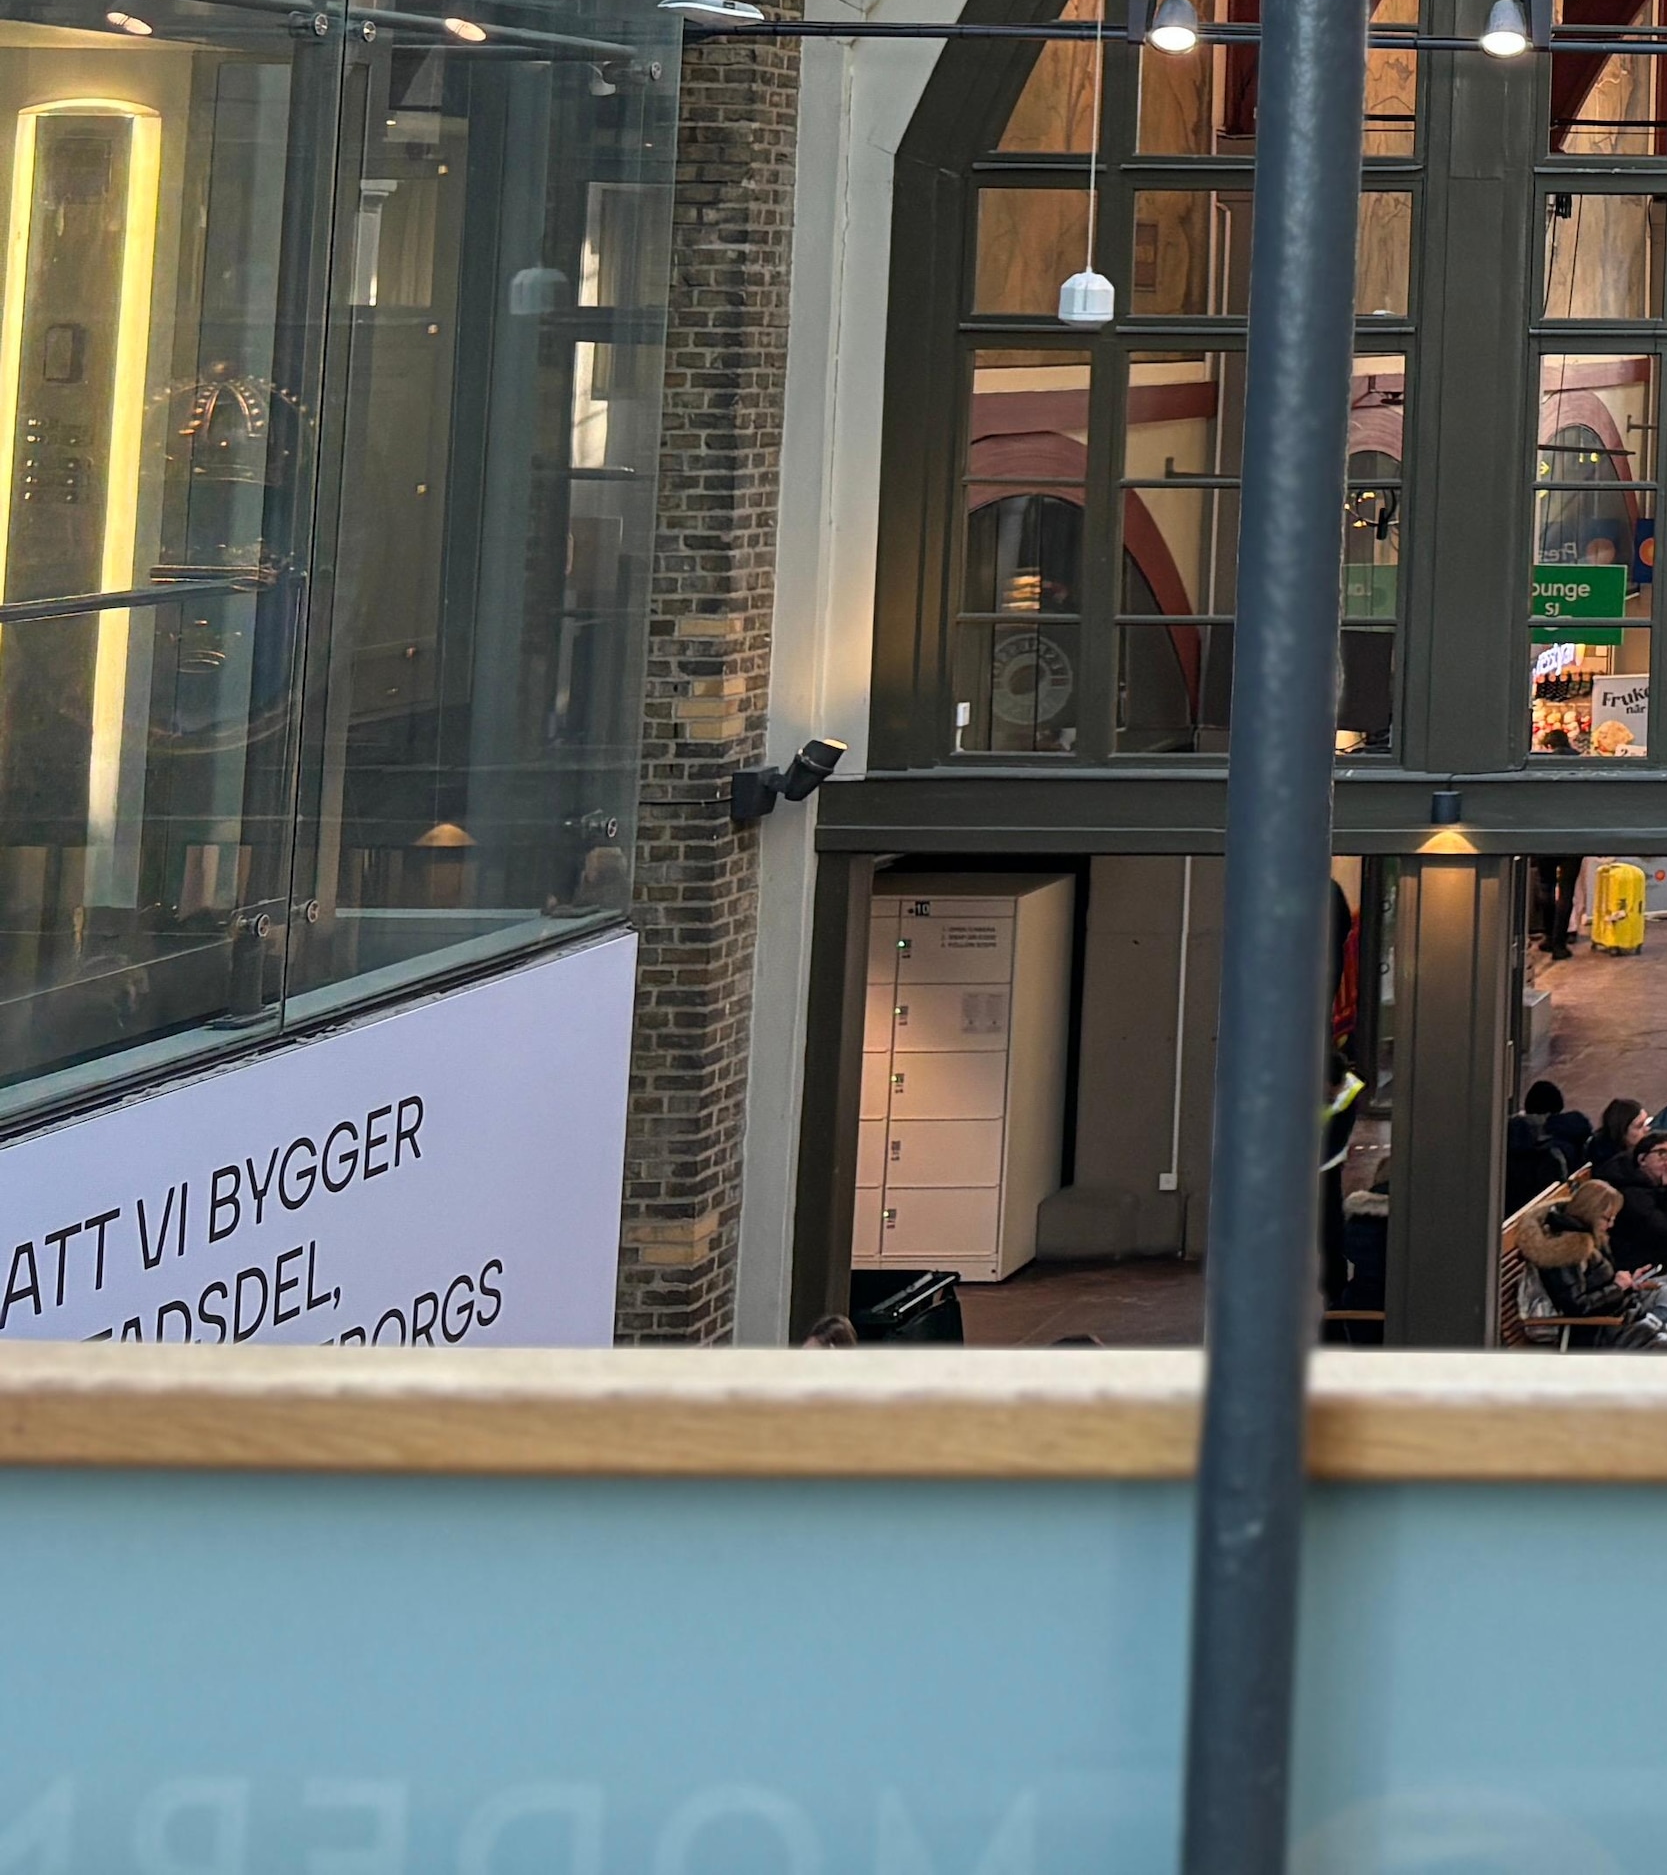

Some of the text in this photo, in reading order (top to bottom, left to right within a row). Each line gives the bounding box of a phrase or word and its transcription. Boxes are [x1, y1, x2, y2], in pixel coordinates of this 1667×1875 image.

[1544, 602, 1560, 617] SJ
[0, 1094, 424, 1327] ATT VI BYGGER
